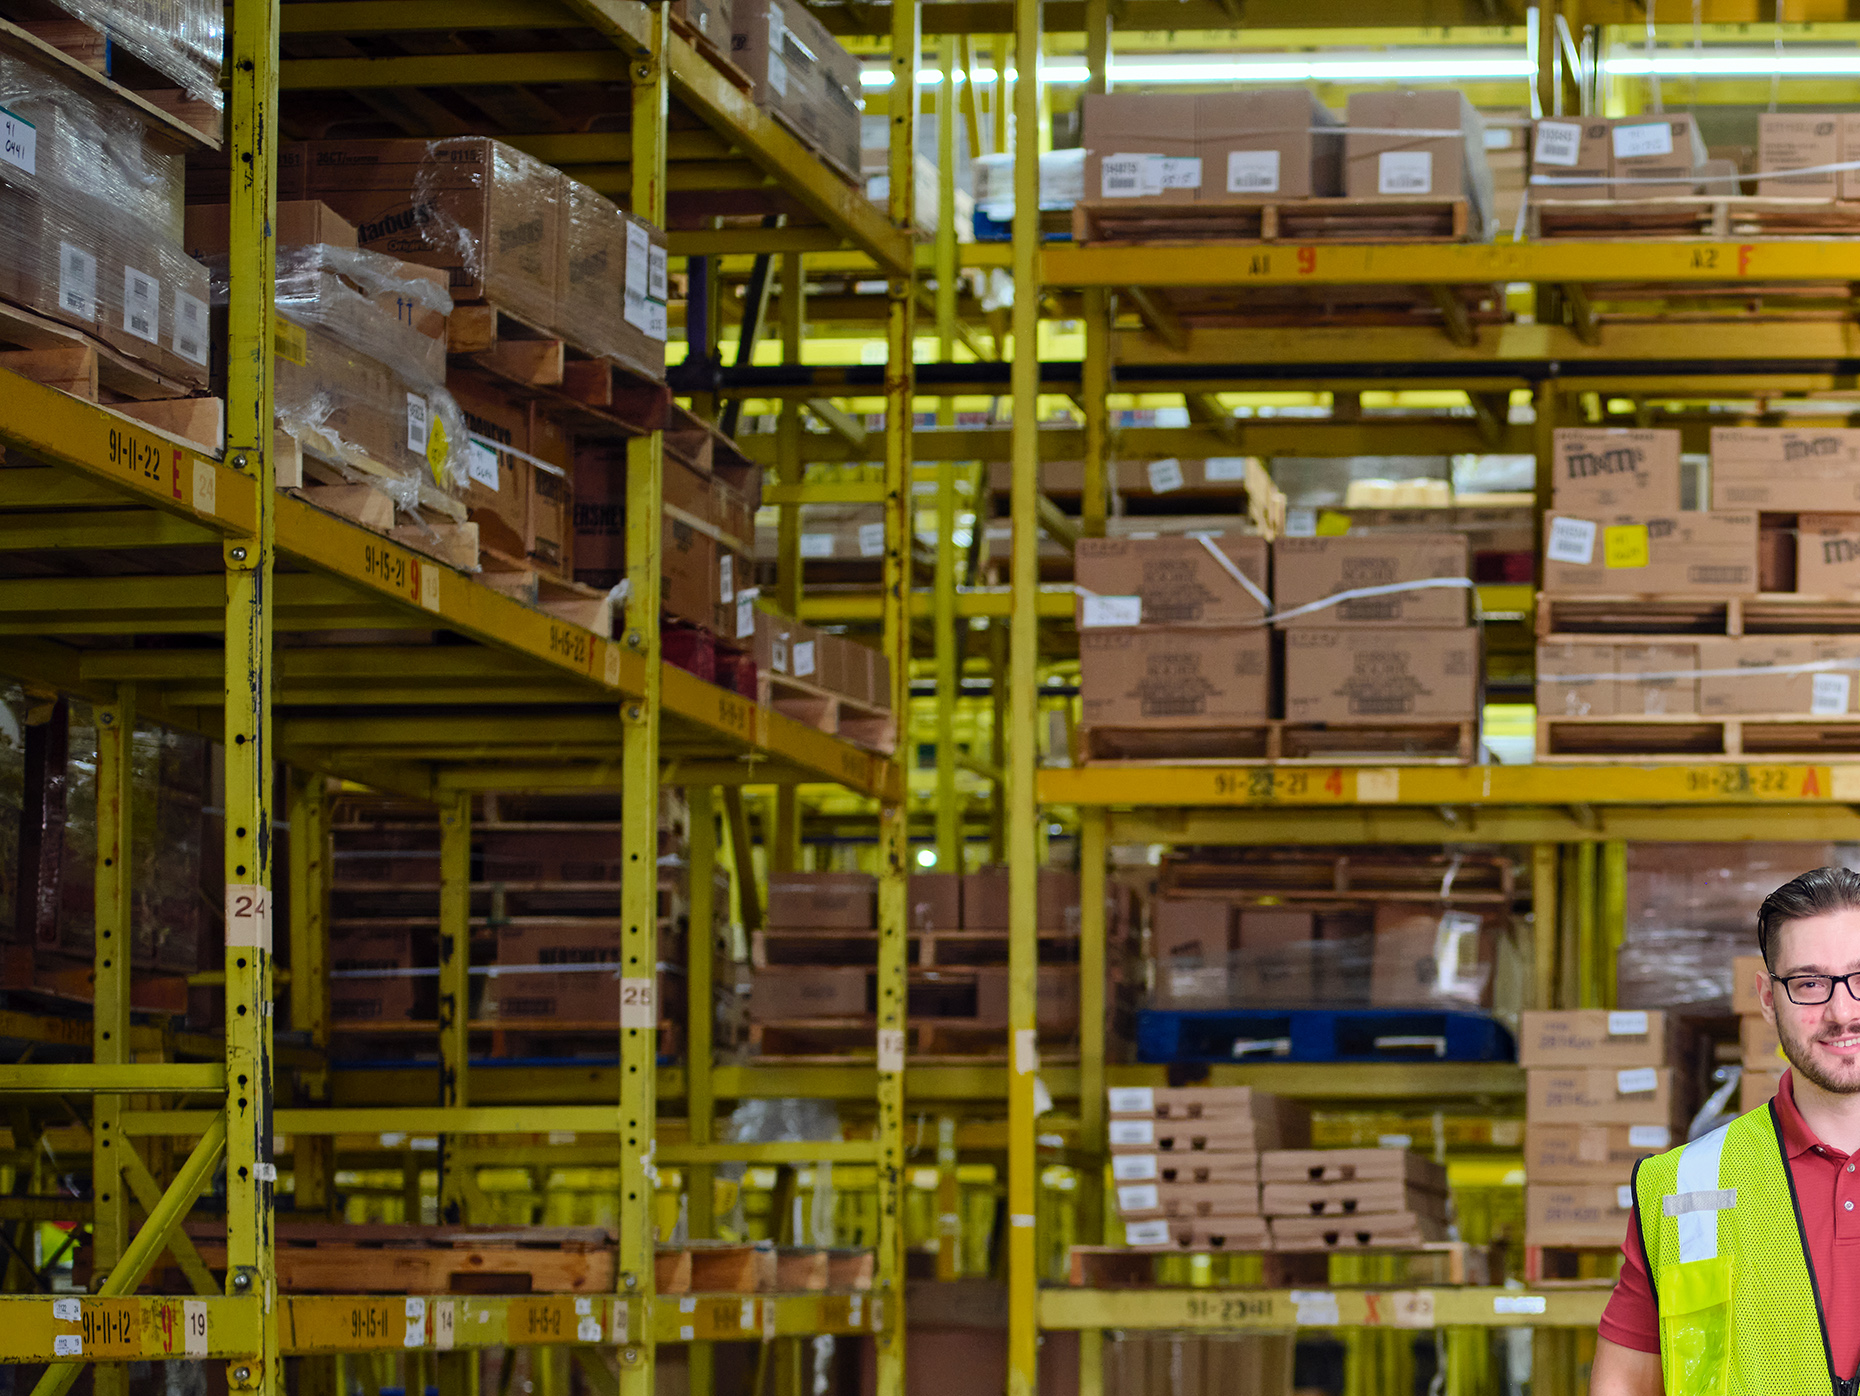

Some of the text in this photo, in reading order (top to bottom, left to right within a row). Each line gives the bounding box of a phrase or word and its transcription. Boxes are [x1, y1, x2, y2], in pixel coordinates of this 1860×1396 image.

[6, 121, 15, 137] 91
[5, 139, 25, 159] 0441
[1297, 246, 1316, 274] 9
[108, 428, 161, 481] 91-11-22
[172, 449, 183, 500] E
[365, 544, 406, 588] 91-15-21
[410, 559, 420, 601] 9
[1801, 766, 1821, 797] A
[234, 896, 267, 918] 24
[623, 986, 653, 1007] 25
[82, 1304, 205, 1353] 91-11-12 9 19
[351, 1308, 388, 1338] 91-15-11
